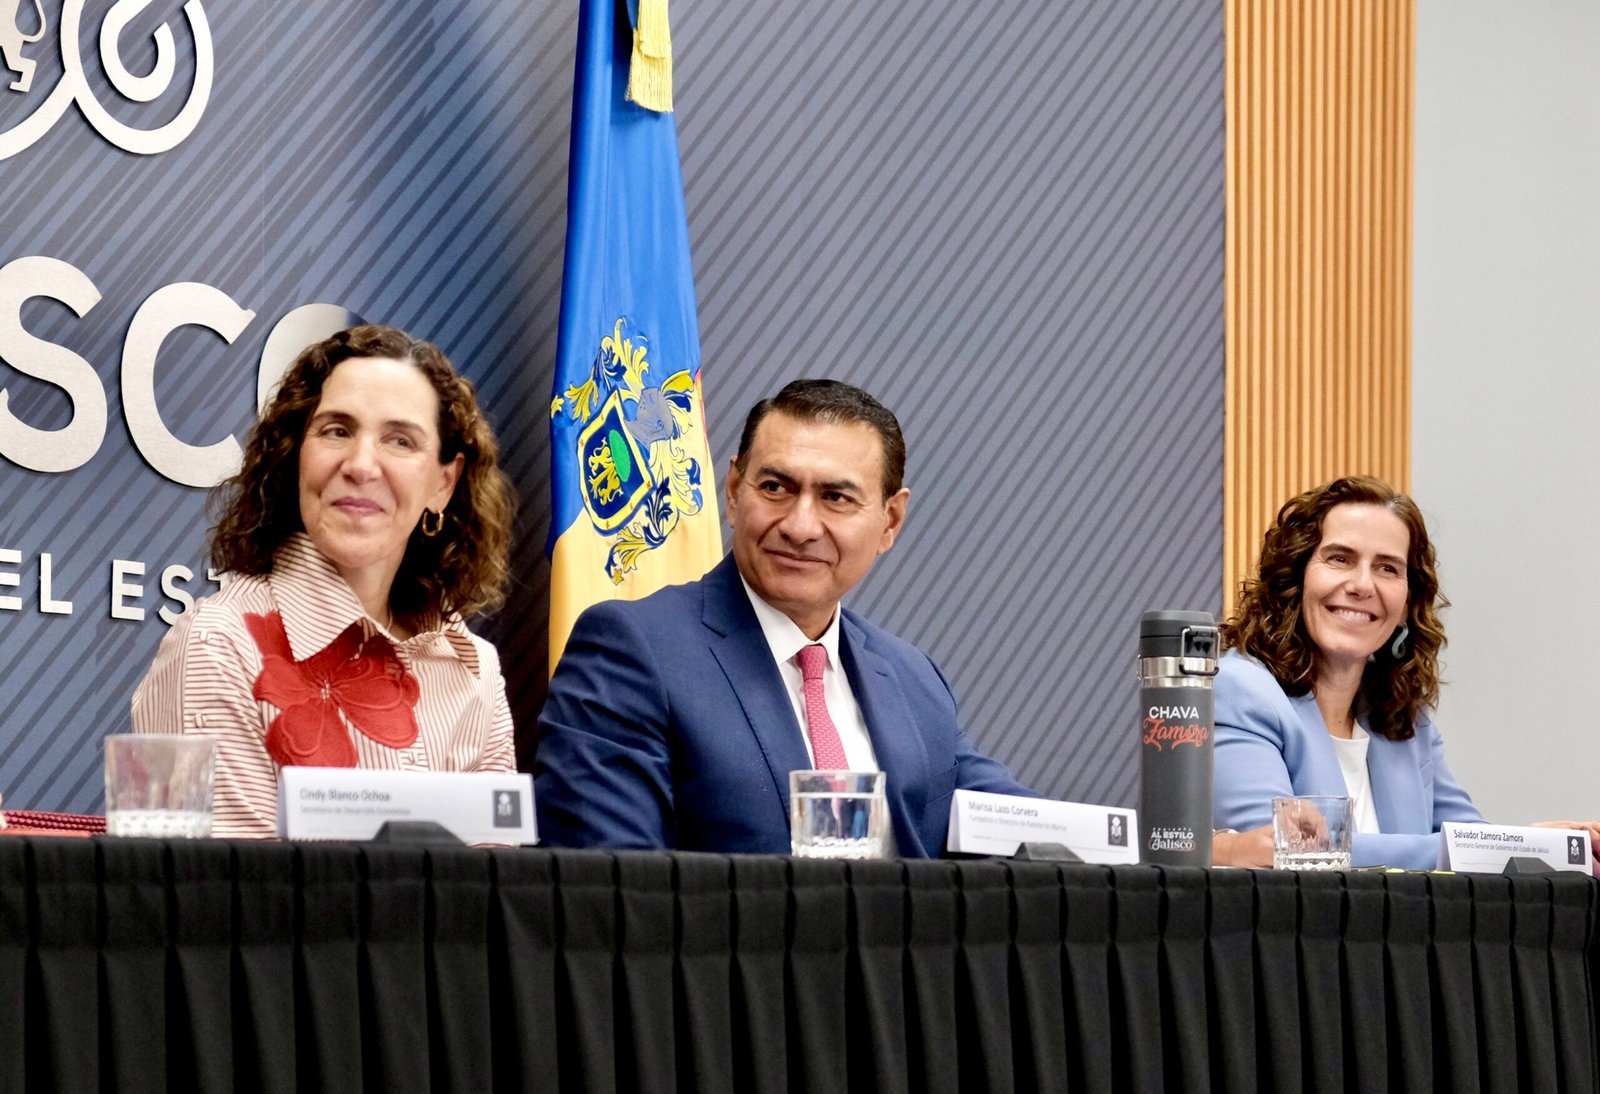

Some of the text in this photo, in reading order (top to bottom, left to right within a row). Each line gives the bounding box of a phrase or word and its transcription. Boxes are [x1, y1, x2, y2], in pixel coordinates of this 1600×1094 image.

[1149, 706, 1199, 719] CHAVA
[1143, 717, 1209, 752] Zamora
[299, 788, 390, 802] Cindy Blanco Ochoa
[968, 801, 992, 812] Marisa
[1012, 805, 1038, 817] Corvera
[1151, 831, 1194, 840] AL ESTILO
[1453, 829, 1524, 843] Salvador Zamora Zamora
[1151, 838, 1193, 851] Jalisco
